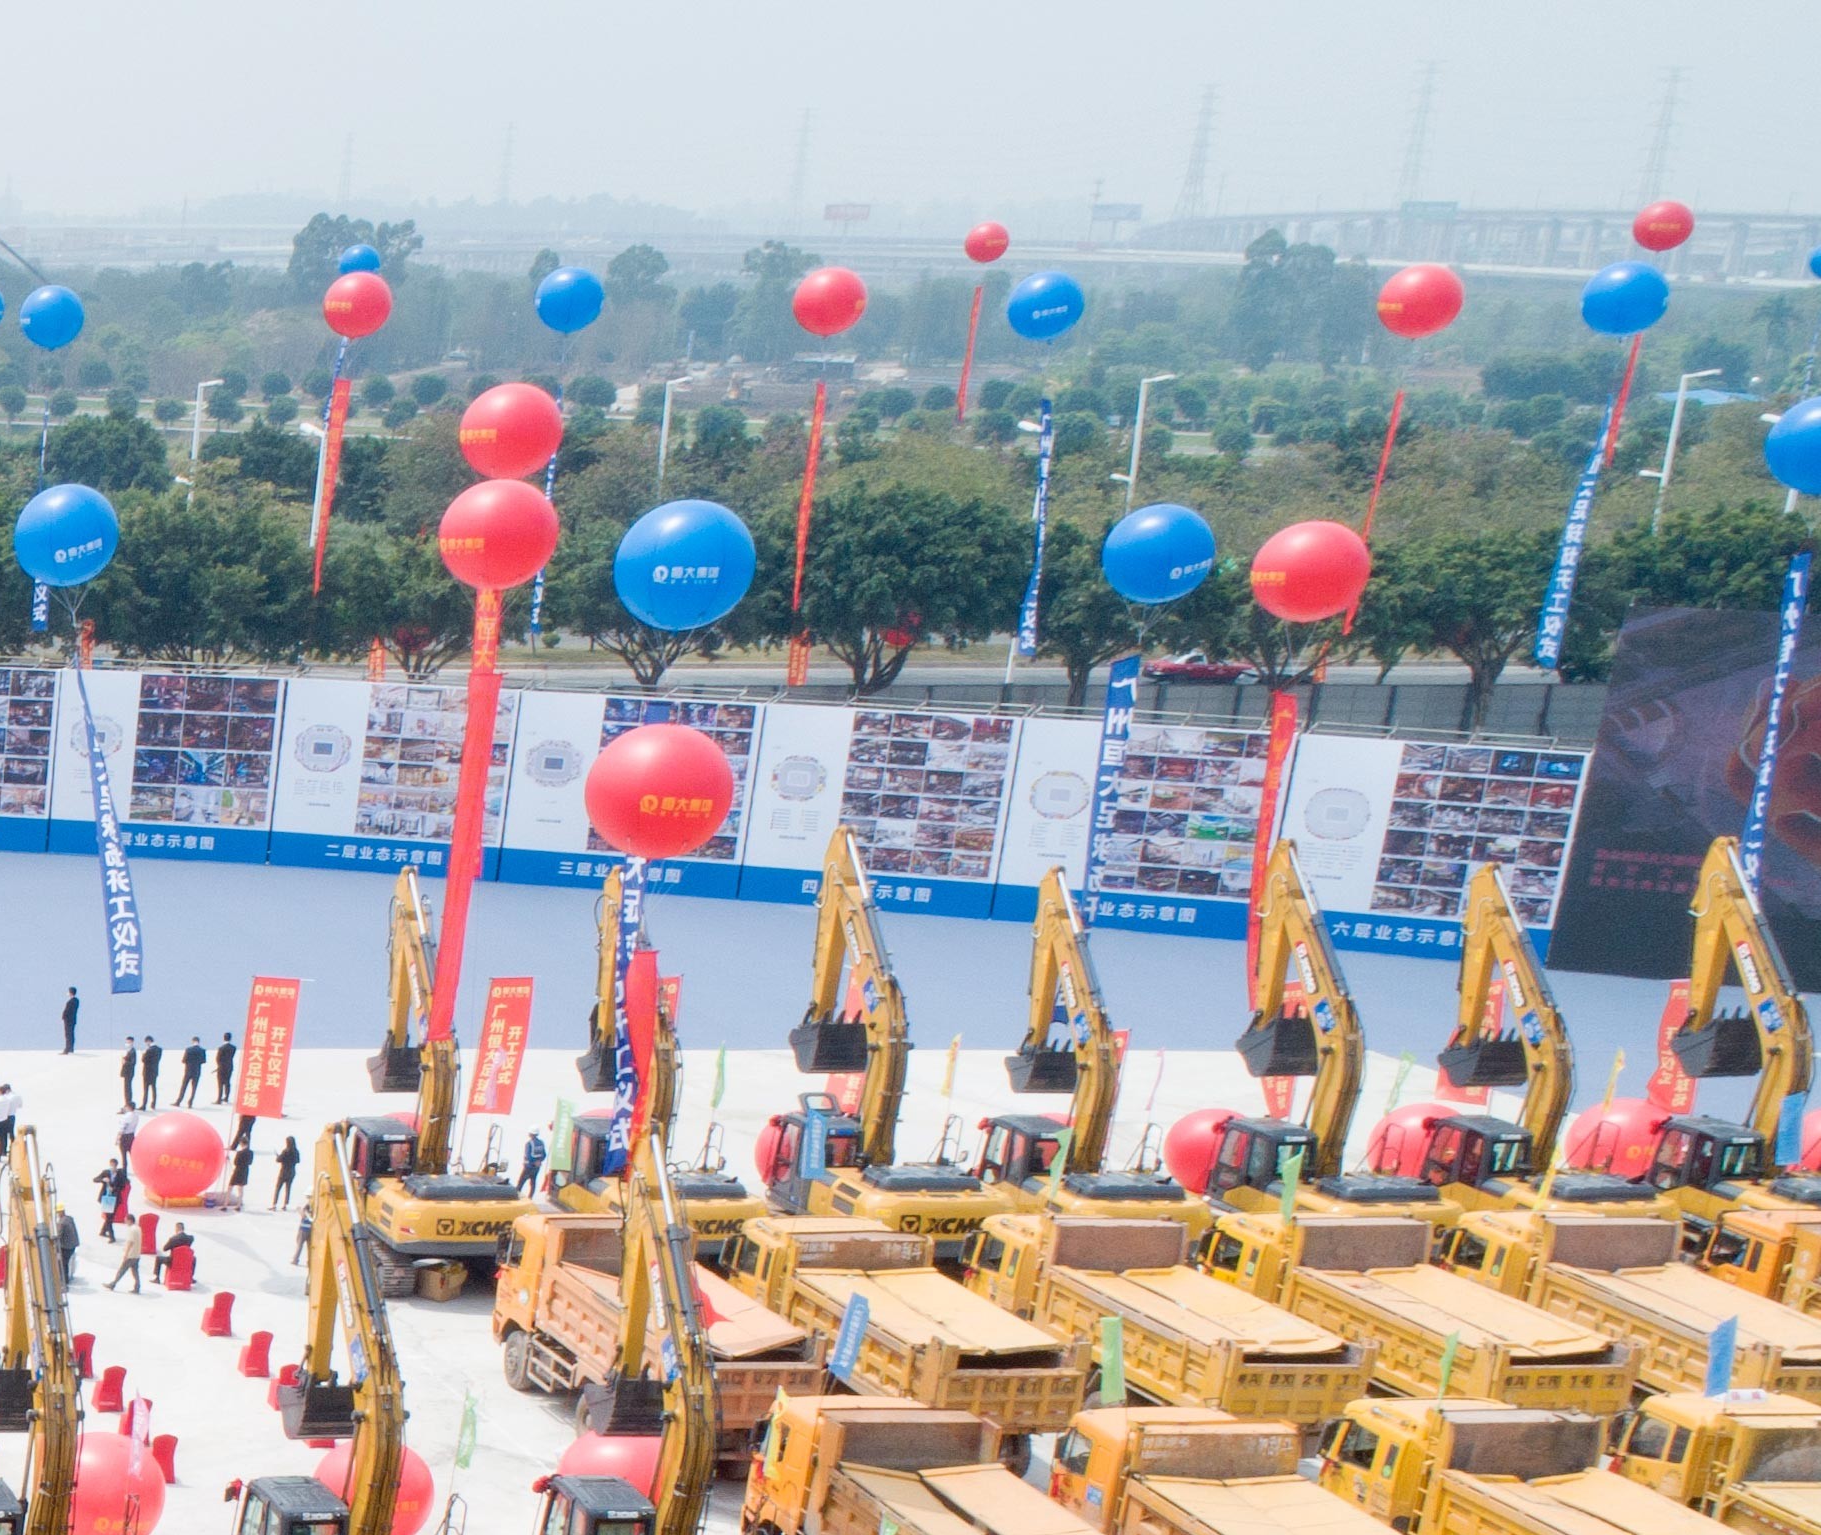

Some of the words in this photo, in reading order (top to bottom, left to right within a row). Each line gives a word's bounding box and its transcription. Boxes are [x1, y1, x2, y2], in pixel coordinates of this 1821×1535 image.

[325, 843, 442, 867] 二层业态示意图
[1332, 921, 1464, 947] 六层业态示意
[243, 1001, 270, 1108] 广州恒大足球场
[265, 1025, 287, 1088] 开工仪式
